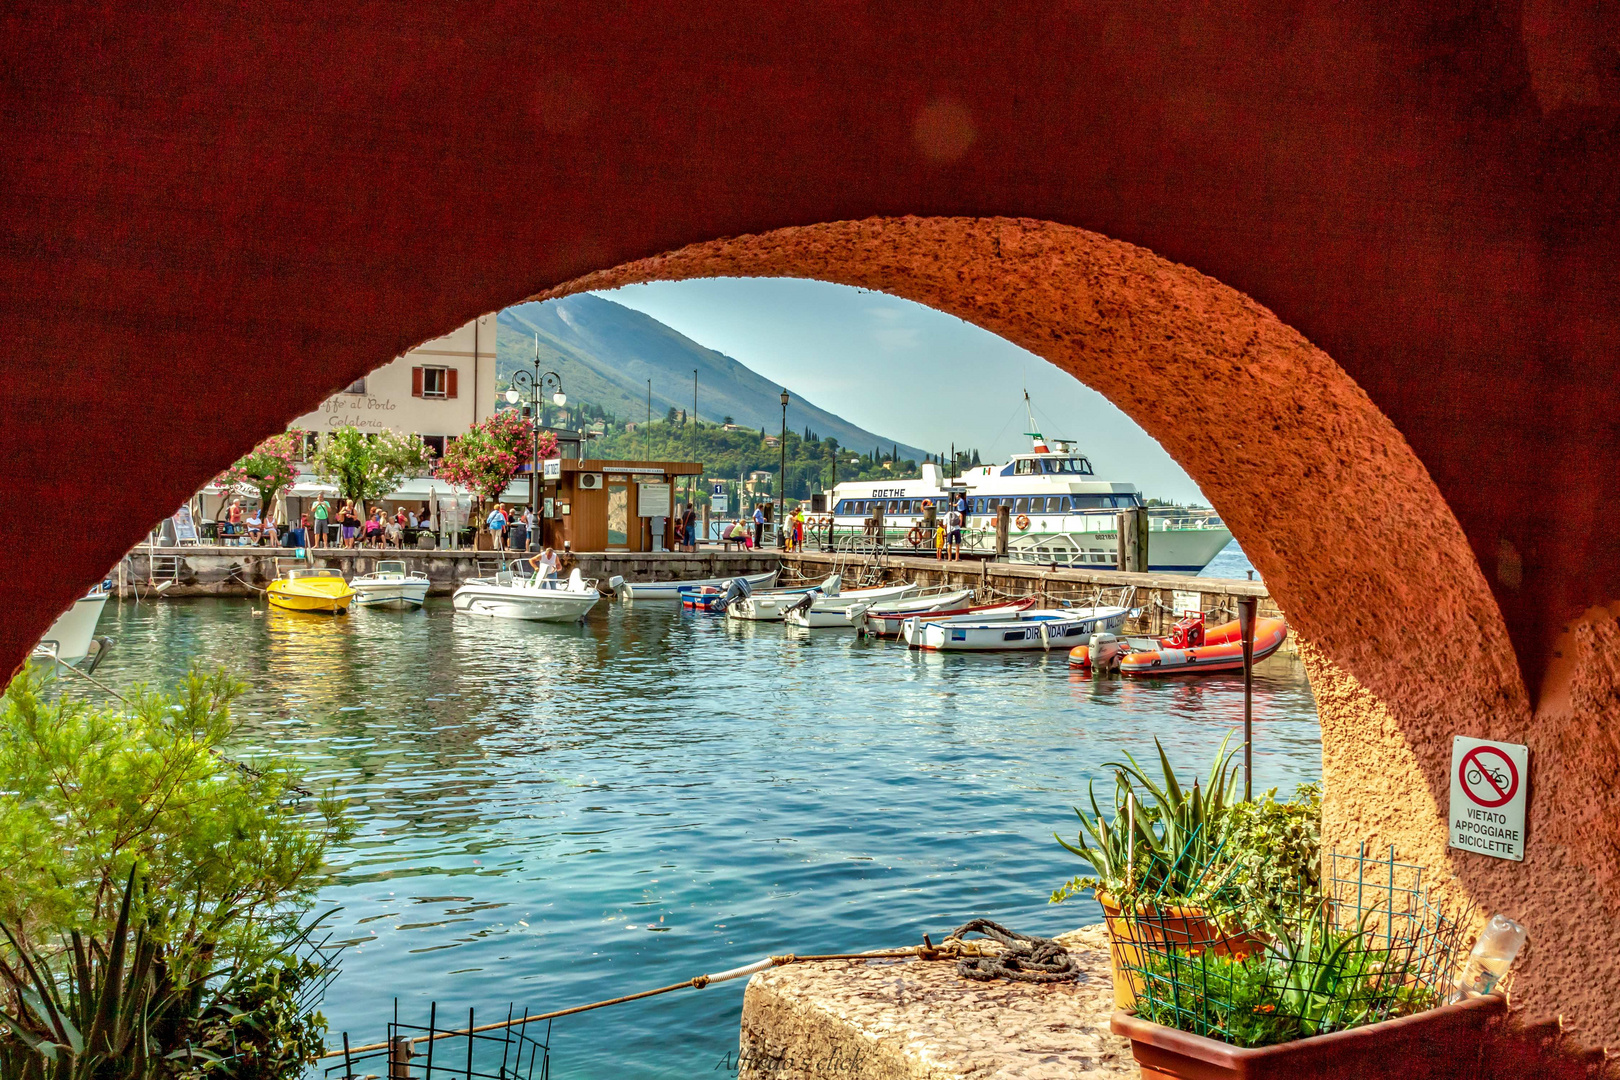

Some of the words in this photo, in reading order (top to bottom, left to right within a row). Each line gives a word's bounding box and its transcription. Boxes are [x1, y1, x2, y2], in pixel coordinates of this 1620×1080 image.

[350, 397, 362, 409] al
[367, 398, 397, 411] Porto
[328, 415, 383, 428] Gelateria
[716, 485, 720, 493] 1
[872, 488, 906, 498] GOETHE
[1467, 808, 1507, 825] VIETATO
[1455, 820, 1519, 841] APPOGGIARE
[1459, 834, 1514, 854] BICICLETTE
